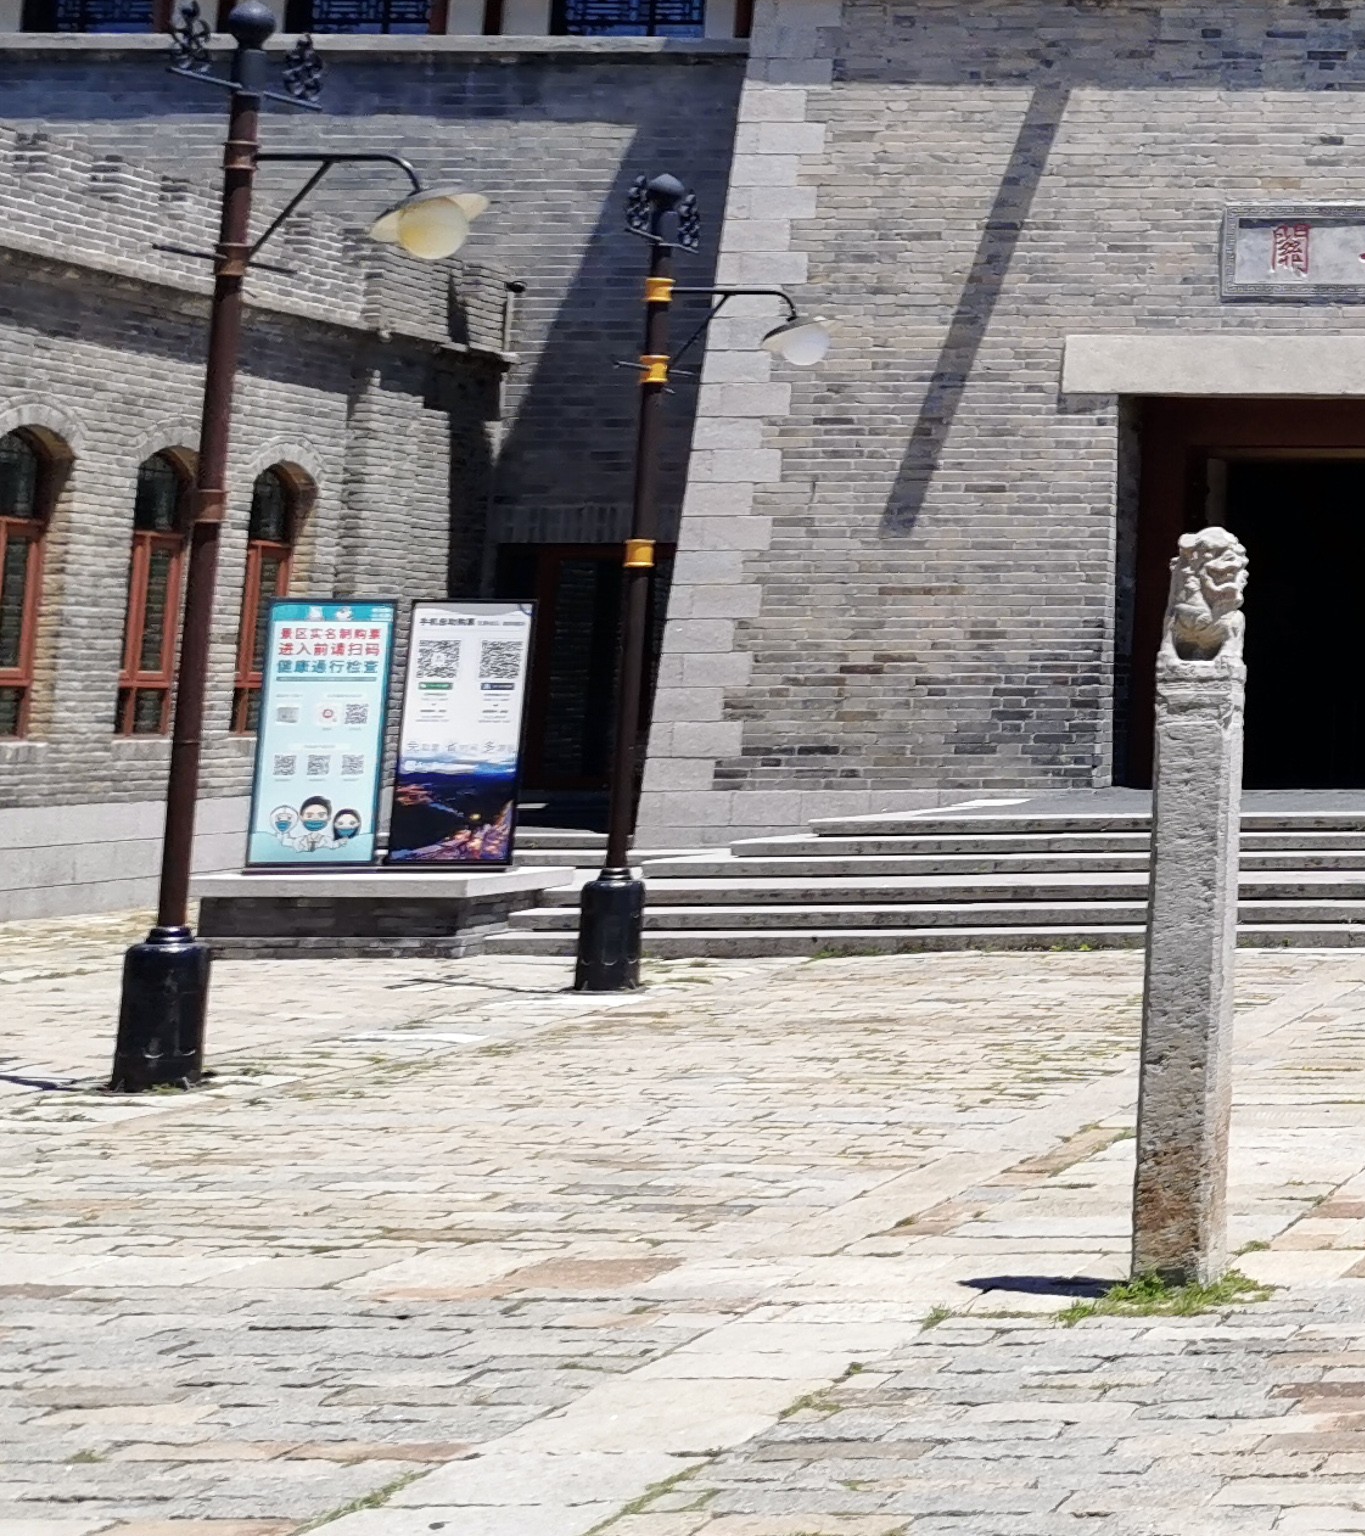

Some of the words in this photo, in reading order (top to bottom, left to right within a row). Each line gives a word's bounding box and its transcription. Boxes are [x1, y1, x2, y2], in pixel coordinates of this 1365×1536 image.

[280, 627, 383, 640] 景区实名制购票
[278, 643, 382, 656] 进入前请扫码
[276, 660, 379, 674] 健康通行检查
